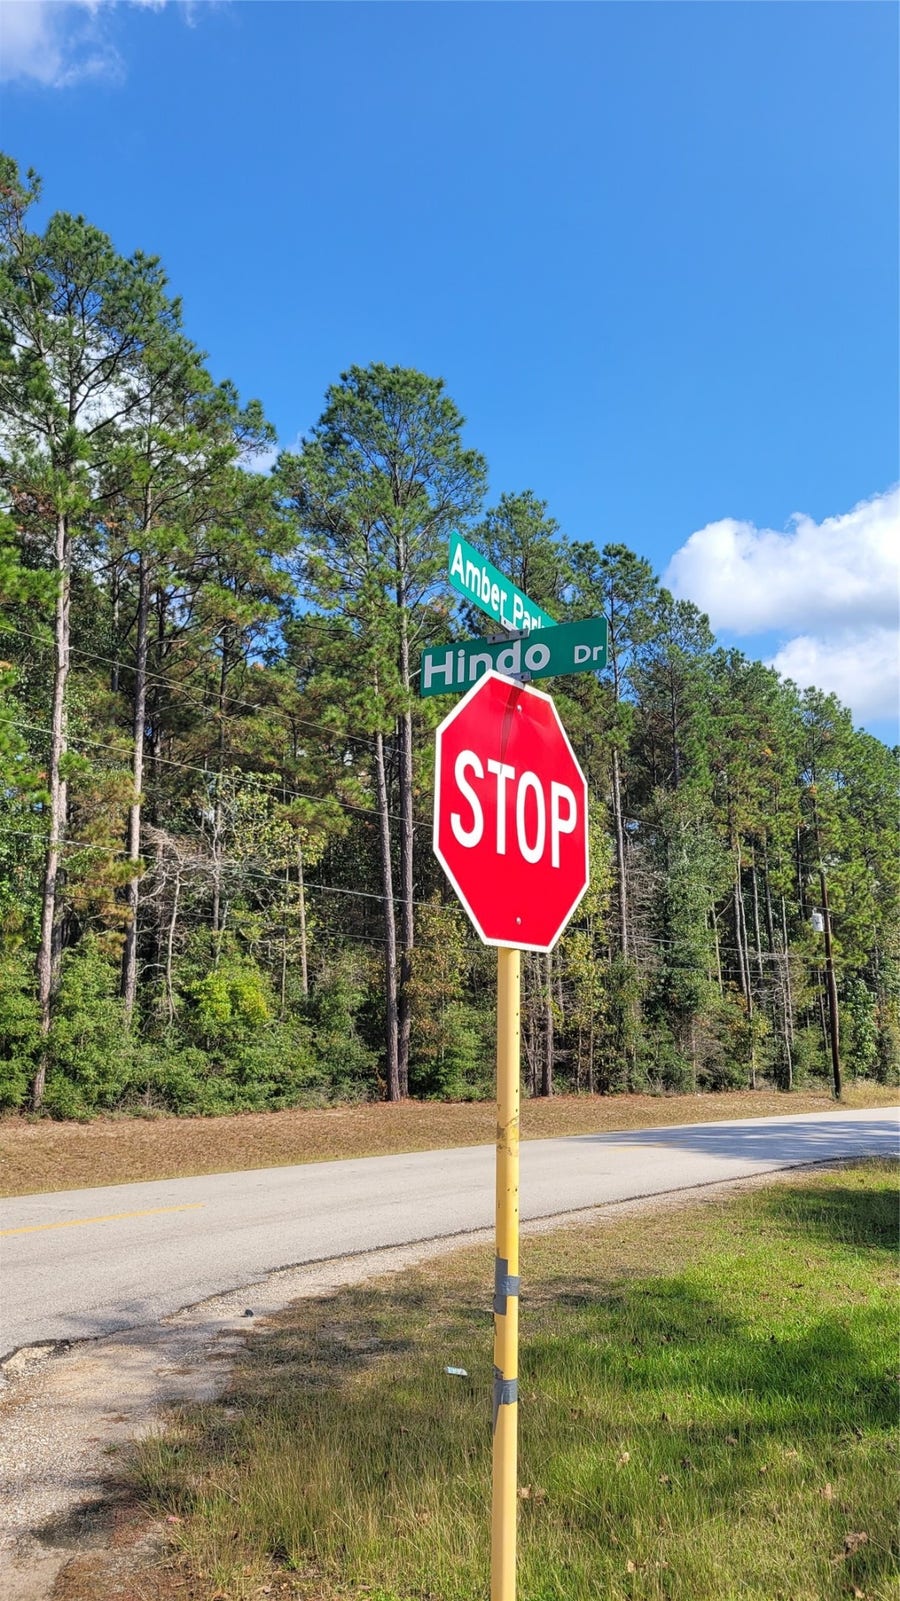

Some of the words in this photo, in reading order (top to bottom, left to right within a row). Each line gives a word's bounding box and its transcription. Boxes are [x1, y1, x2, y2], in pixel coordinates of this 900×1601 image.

[450, 543, 508, 619] Amber
[423, 639, 551, 689] Hindo
[574, 645, 603, 664] Dr
[450, 750, 577, 869] STOP
